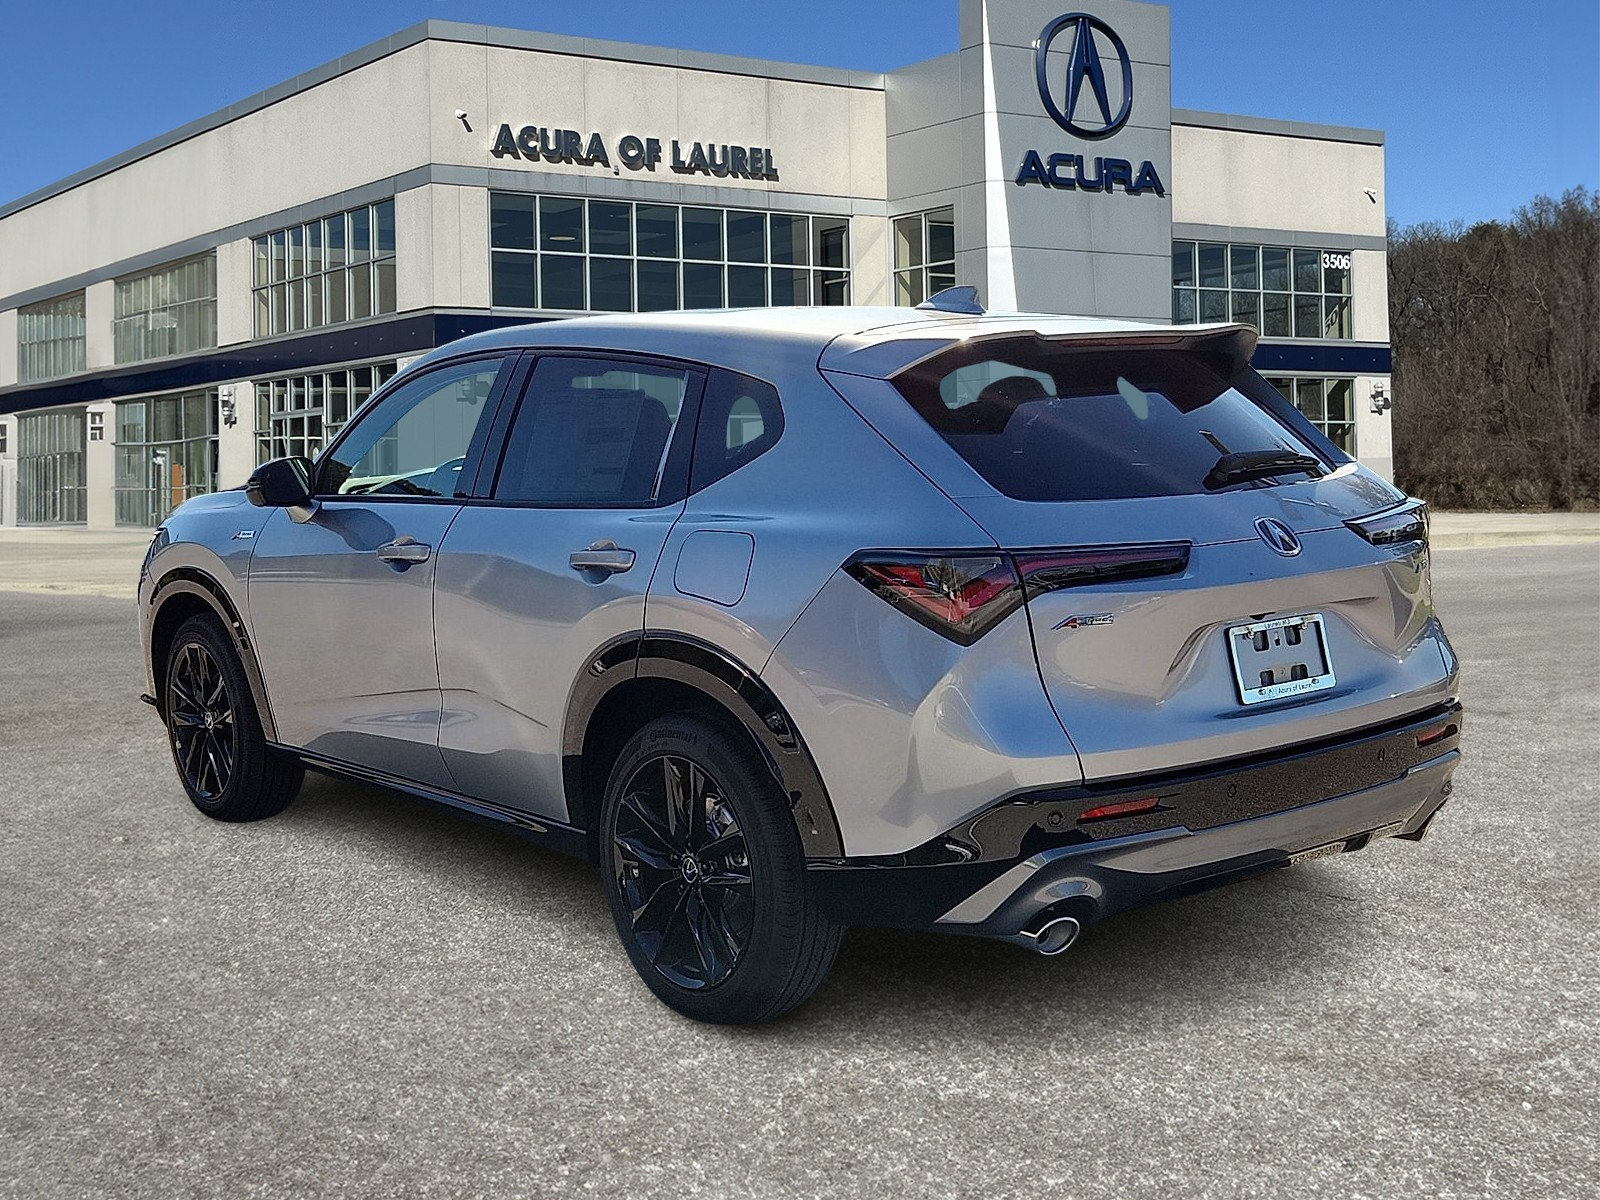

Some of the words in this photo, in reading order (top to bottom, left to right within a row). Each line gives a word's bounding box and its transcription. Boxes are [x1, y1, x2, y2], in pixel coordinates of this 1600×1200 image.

[490, 123, 611, 168] ACURA
[617, 135, 662, 171] OF
[670, 140, 779, 181] LAUREL
[1015, 149, 1165, 198] ACURA
[1322, 253, 1351, 270] 3506
